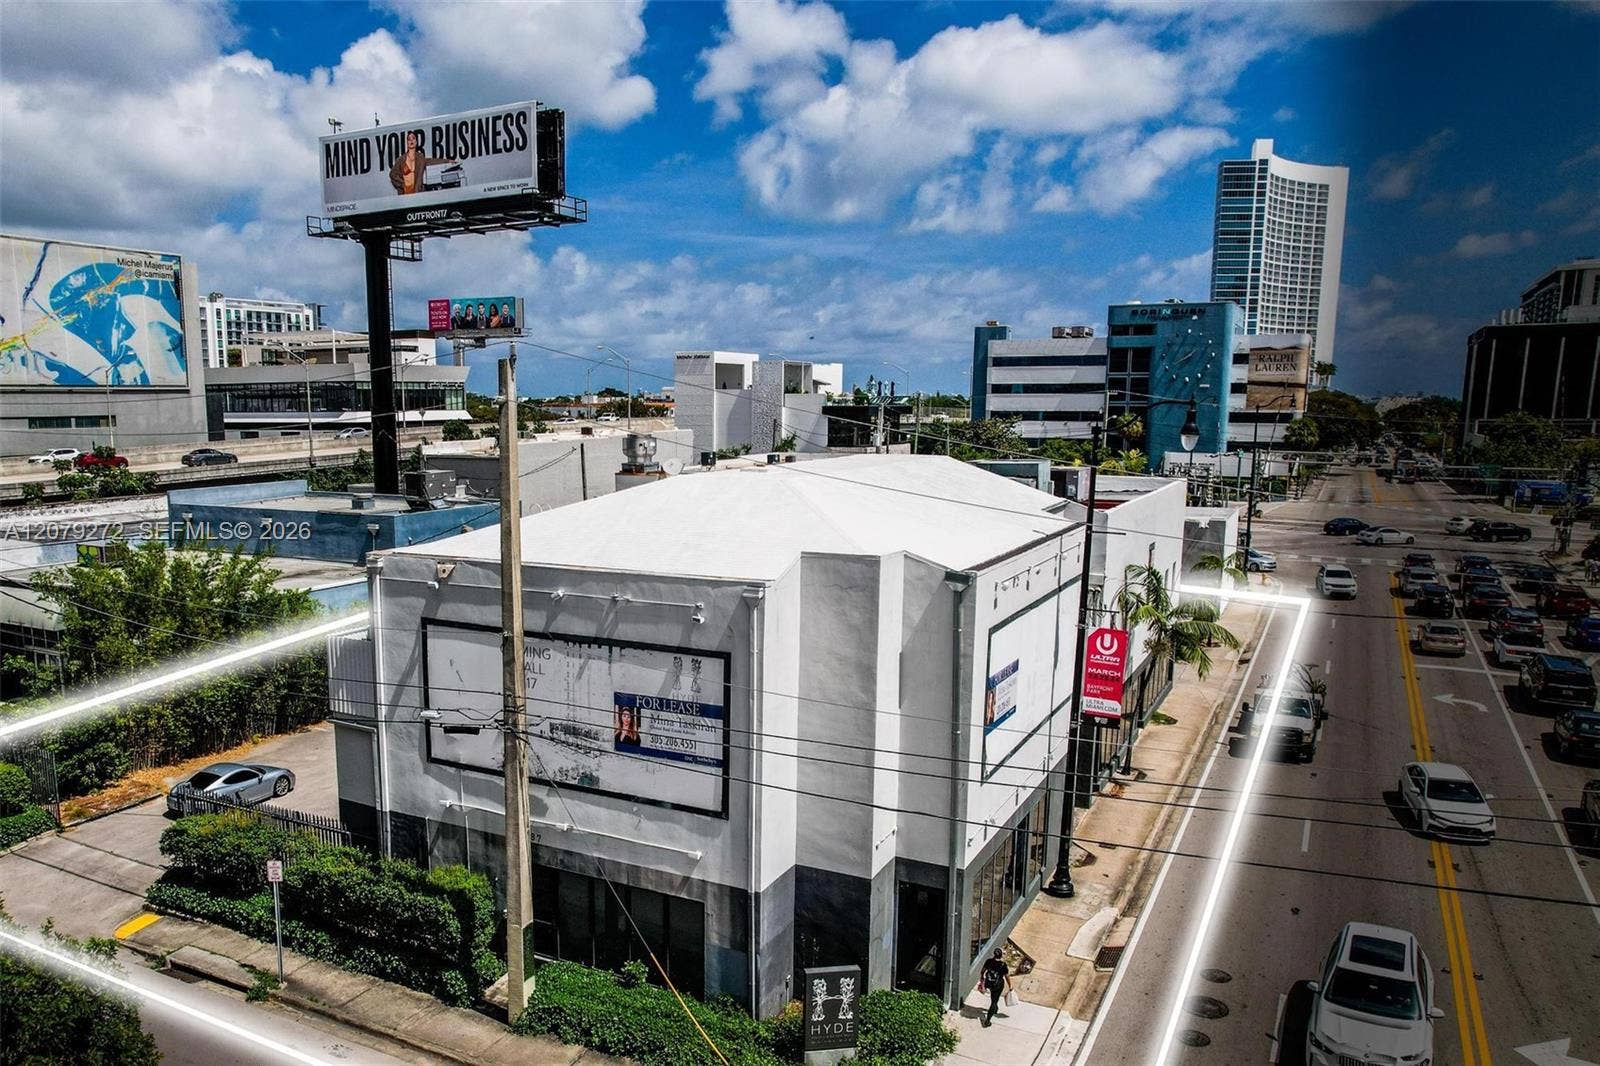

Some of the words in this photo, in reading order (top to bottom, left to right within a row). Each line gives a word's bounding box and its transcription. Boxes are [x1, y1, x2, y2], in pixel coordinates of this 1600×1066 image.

[325, 138, 371, 178] MIND
[432, 111, 528, 160] BUSINESS
[116, 257, 142, 268] Michel
[144, 260, 174, 271] Majerus
[1258, 353, 1295, 362] RALPH
[1255, 362, 1297, 371] LAUREN
[1087, 667, 1121, 677] MARCH
[636, 695, 661, 710] FOR
[663, 698, 701, 715] LEASE
[811, 1021, 854, 1036] HYDE
